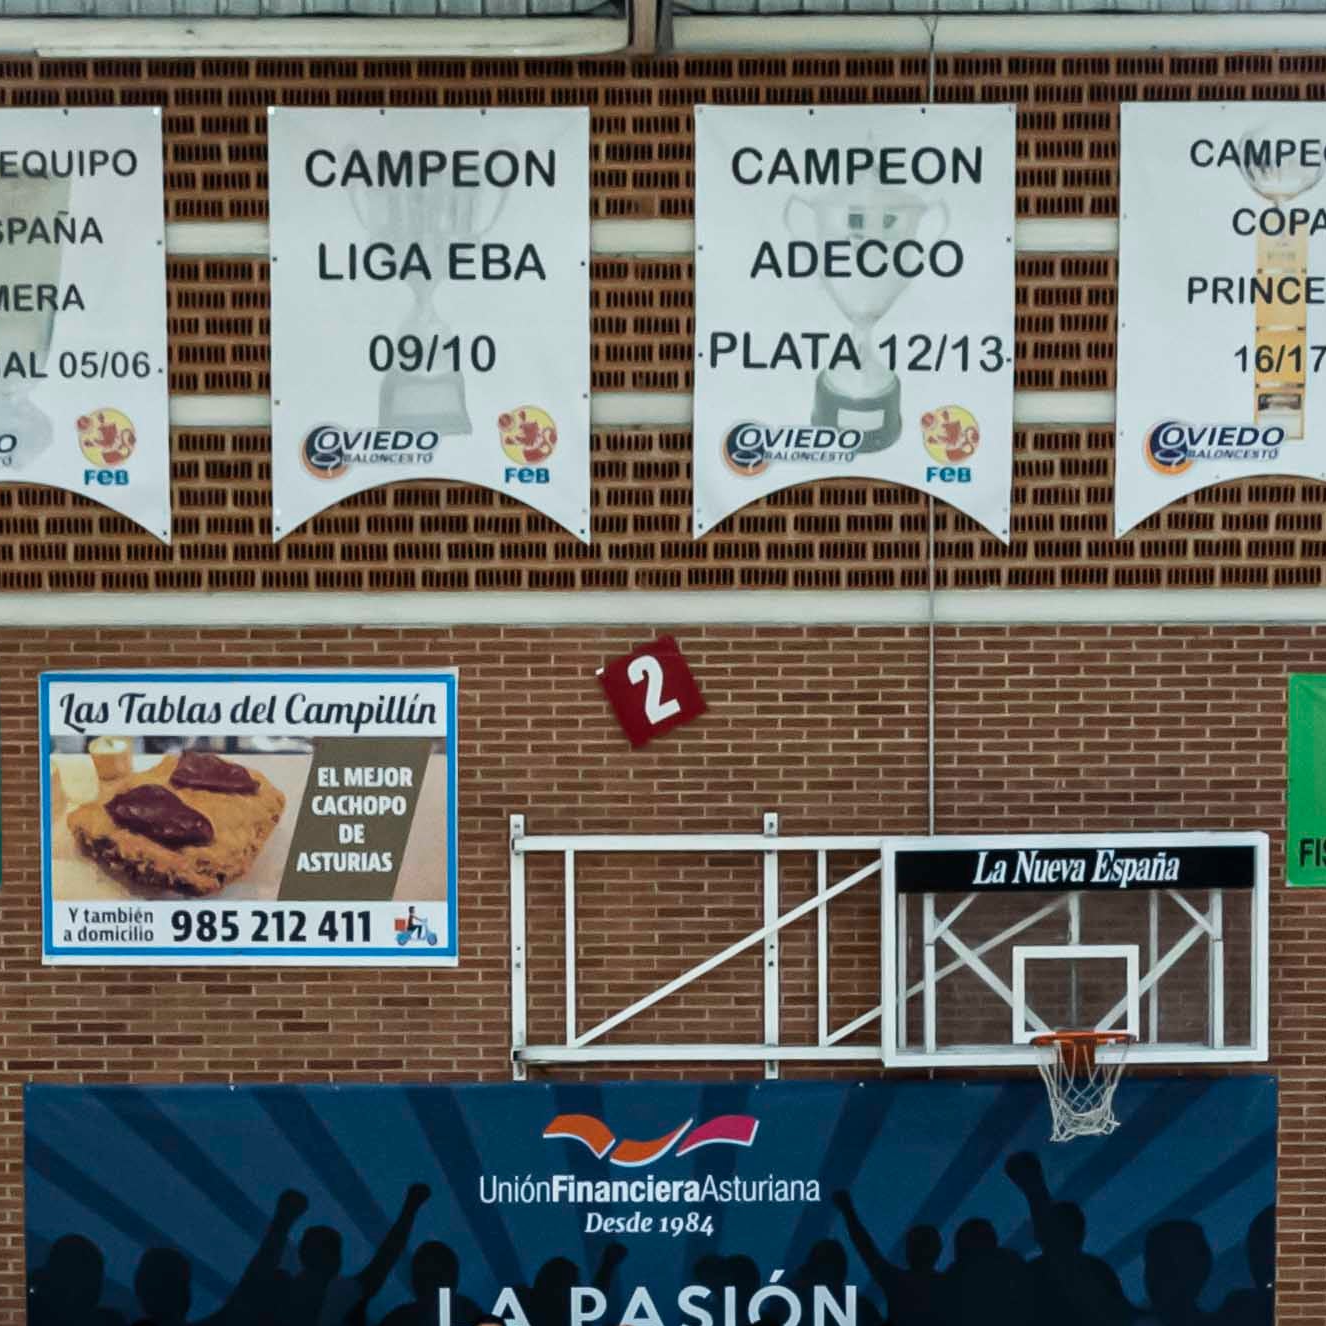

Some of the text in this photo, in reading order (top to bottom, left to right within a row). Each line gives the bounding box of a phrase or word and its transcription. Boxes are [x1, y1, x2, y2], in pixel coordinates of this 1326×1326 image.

[0, 149, 138, 180] EQUIPO
[304, 149, 556, 188] CAMPEON
[731, 146, 983, 185] CAMPEON
[318, 242, 546, 281] LIGA EBA
[750, 240, 964, 279] ADECCO
[59, 351, 151, 379] 05/06
[369, 334, 497, 373] 09/10
[709, 332, 1004, 373] PLATA 12/13
[315, 430, 439, 453] OVIEDO
[738, 428, 862, 450] OVIEDO
[1161, 425, 1285, 448] OVIEDO
[627, 653, 682, 727] 2
[59, 692, 437, 733] Las Tablas del Campillín
[318, 767, 413, 787] EL MEJOR
[312, 795, 407, 816] CACHOPO
[339, 823, 366, 844] DE
[297, 852, 393, 872] ASTURIAS
[973, 847, 1181, 887] La Nueva España
[69, 906, 154, 924] Y también
[171, 909, 372, 943] 985 212 411
[64, 924, 154, 942] a domicilio
[585, 1212, 714, 1236] Desde 1984
